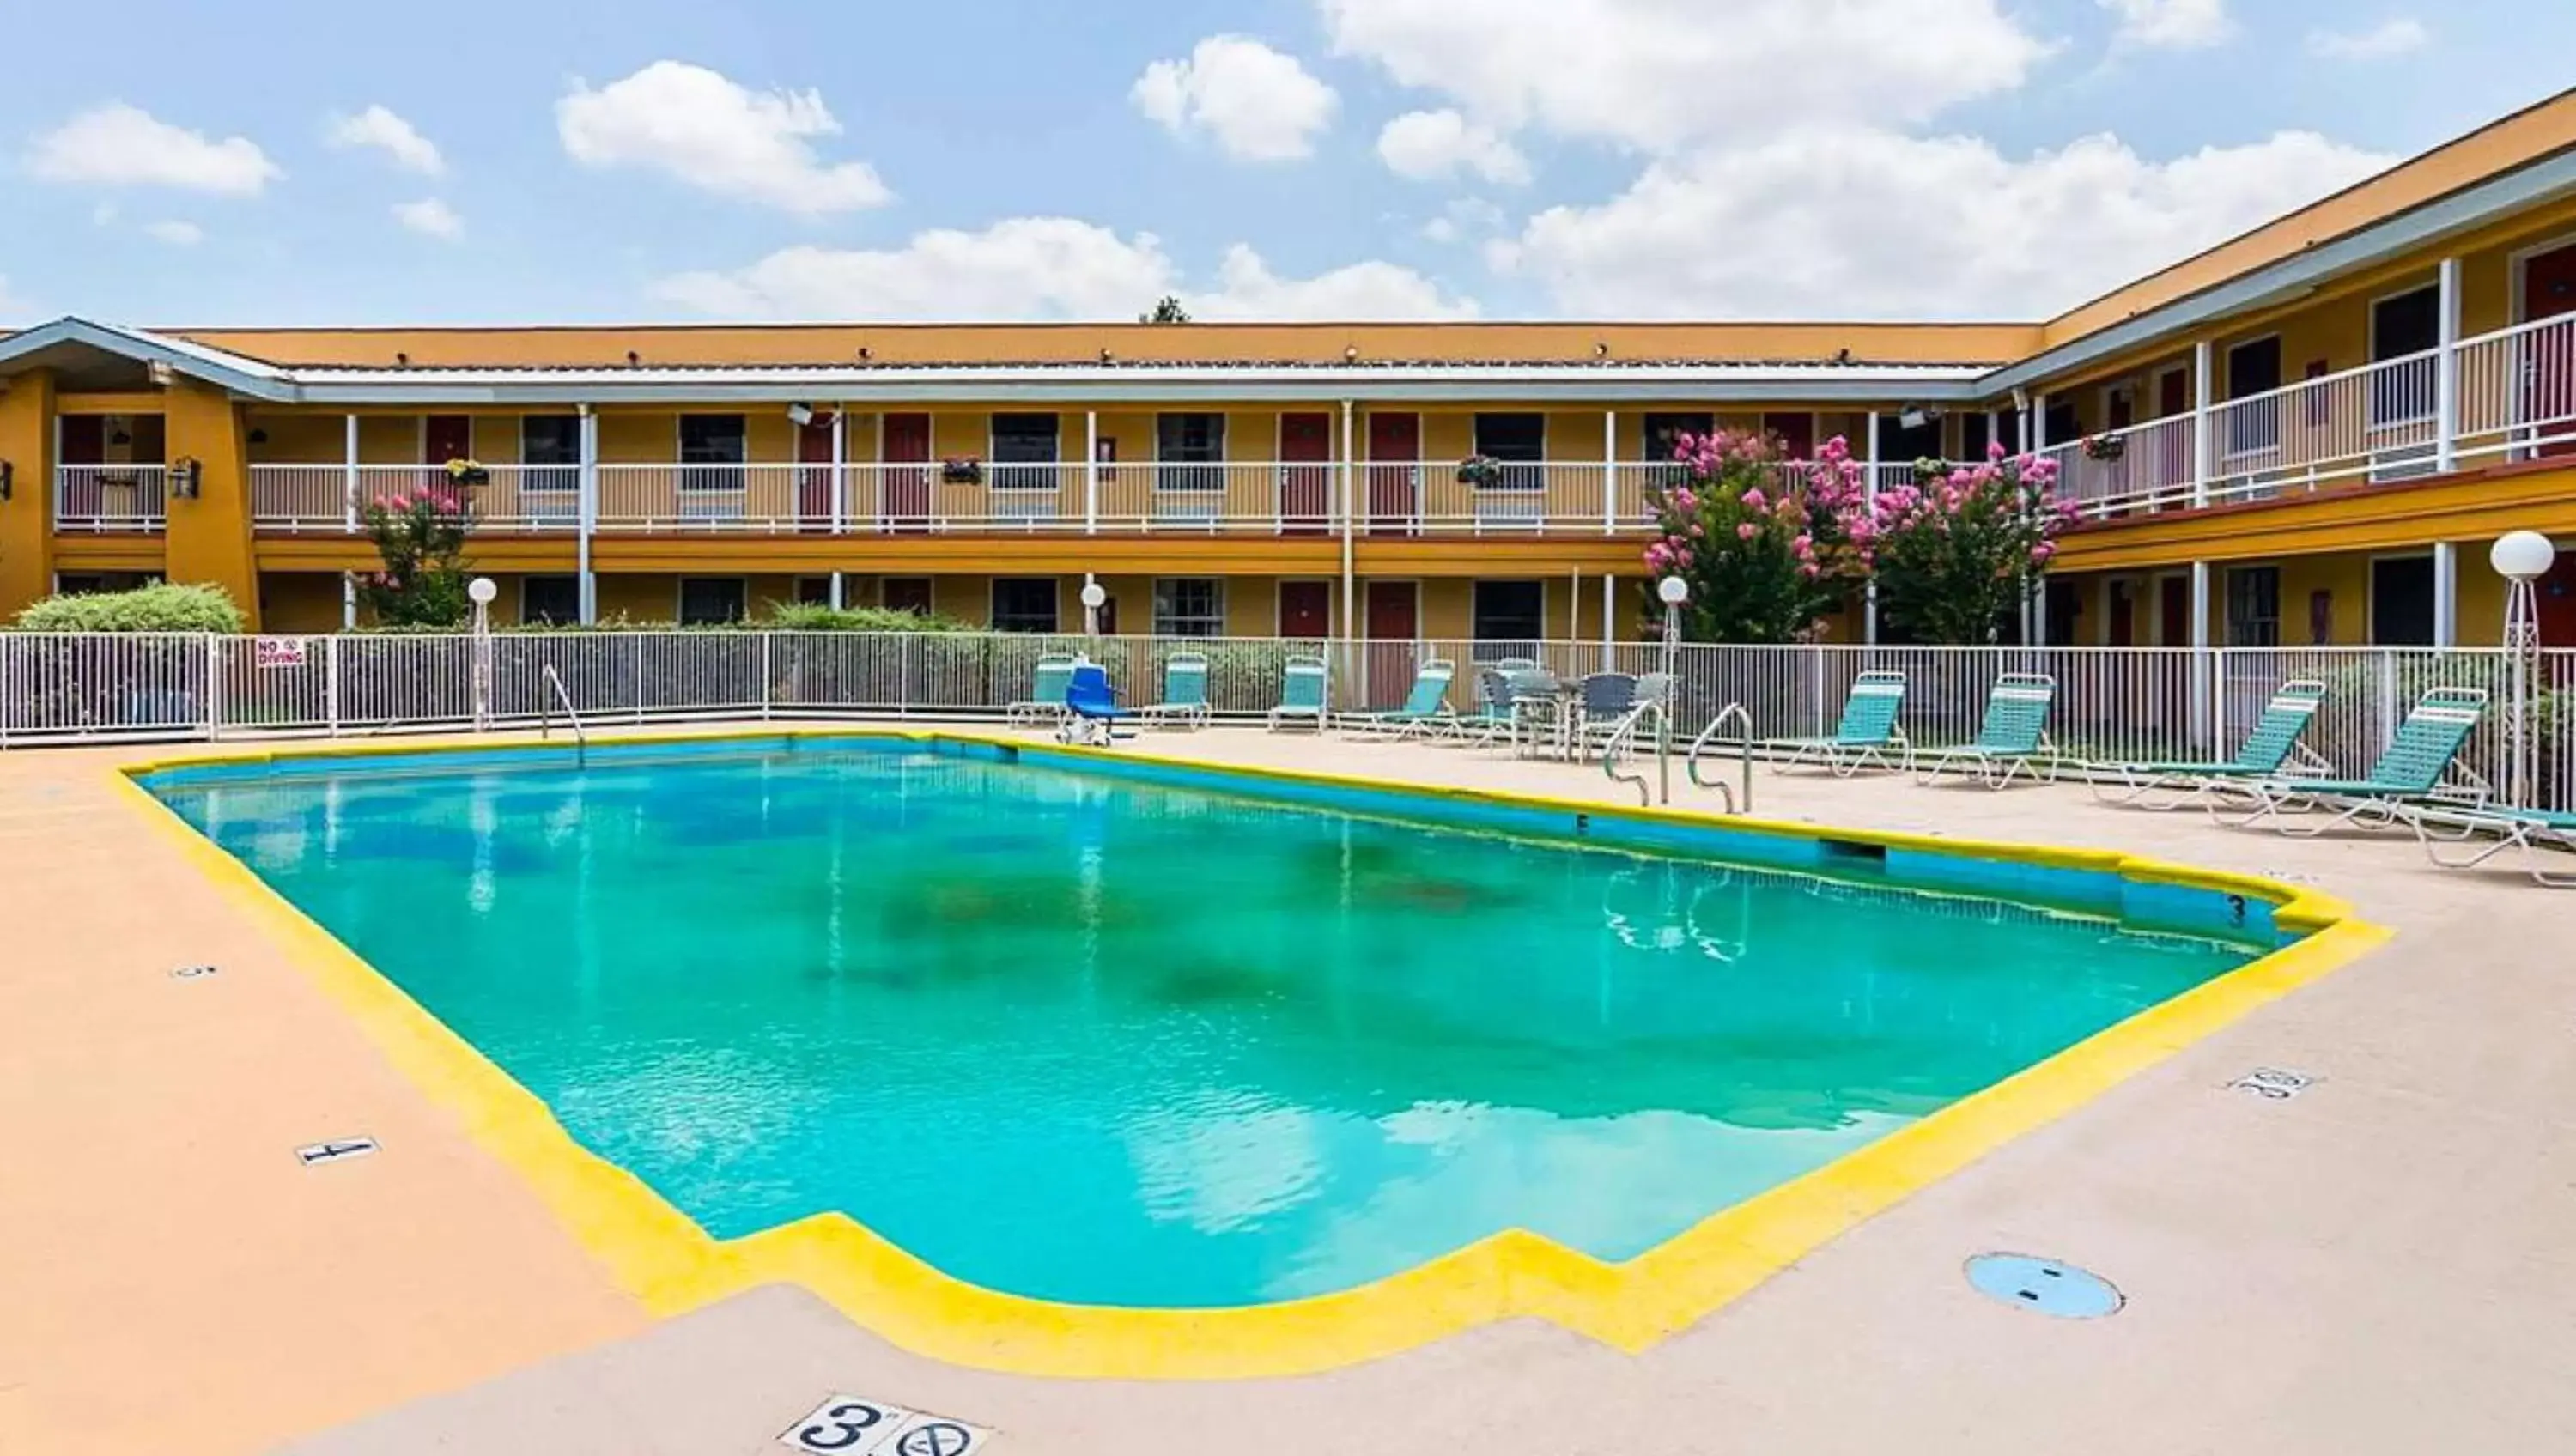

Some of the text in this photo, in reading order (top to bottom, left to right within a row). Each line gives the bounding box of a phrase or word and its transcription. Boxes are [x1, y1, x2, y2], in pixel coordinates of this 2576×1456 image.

[258, 640, 277, 652] NO
[258, 652, 303, 664] DIVING
[2227, 894, 2246, 929] 3
[303, 1144, 372, 1162] 4
[799, 1404, 882, 1449] 3
